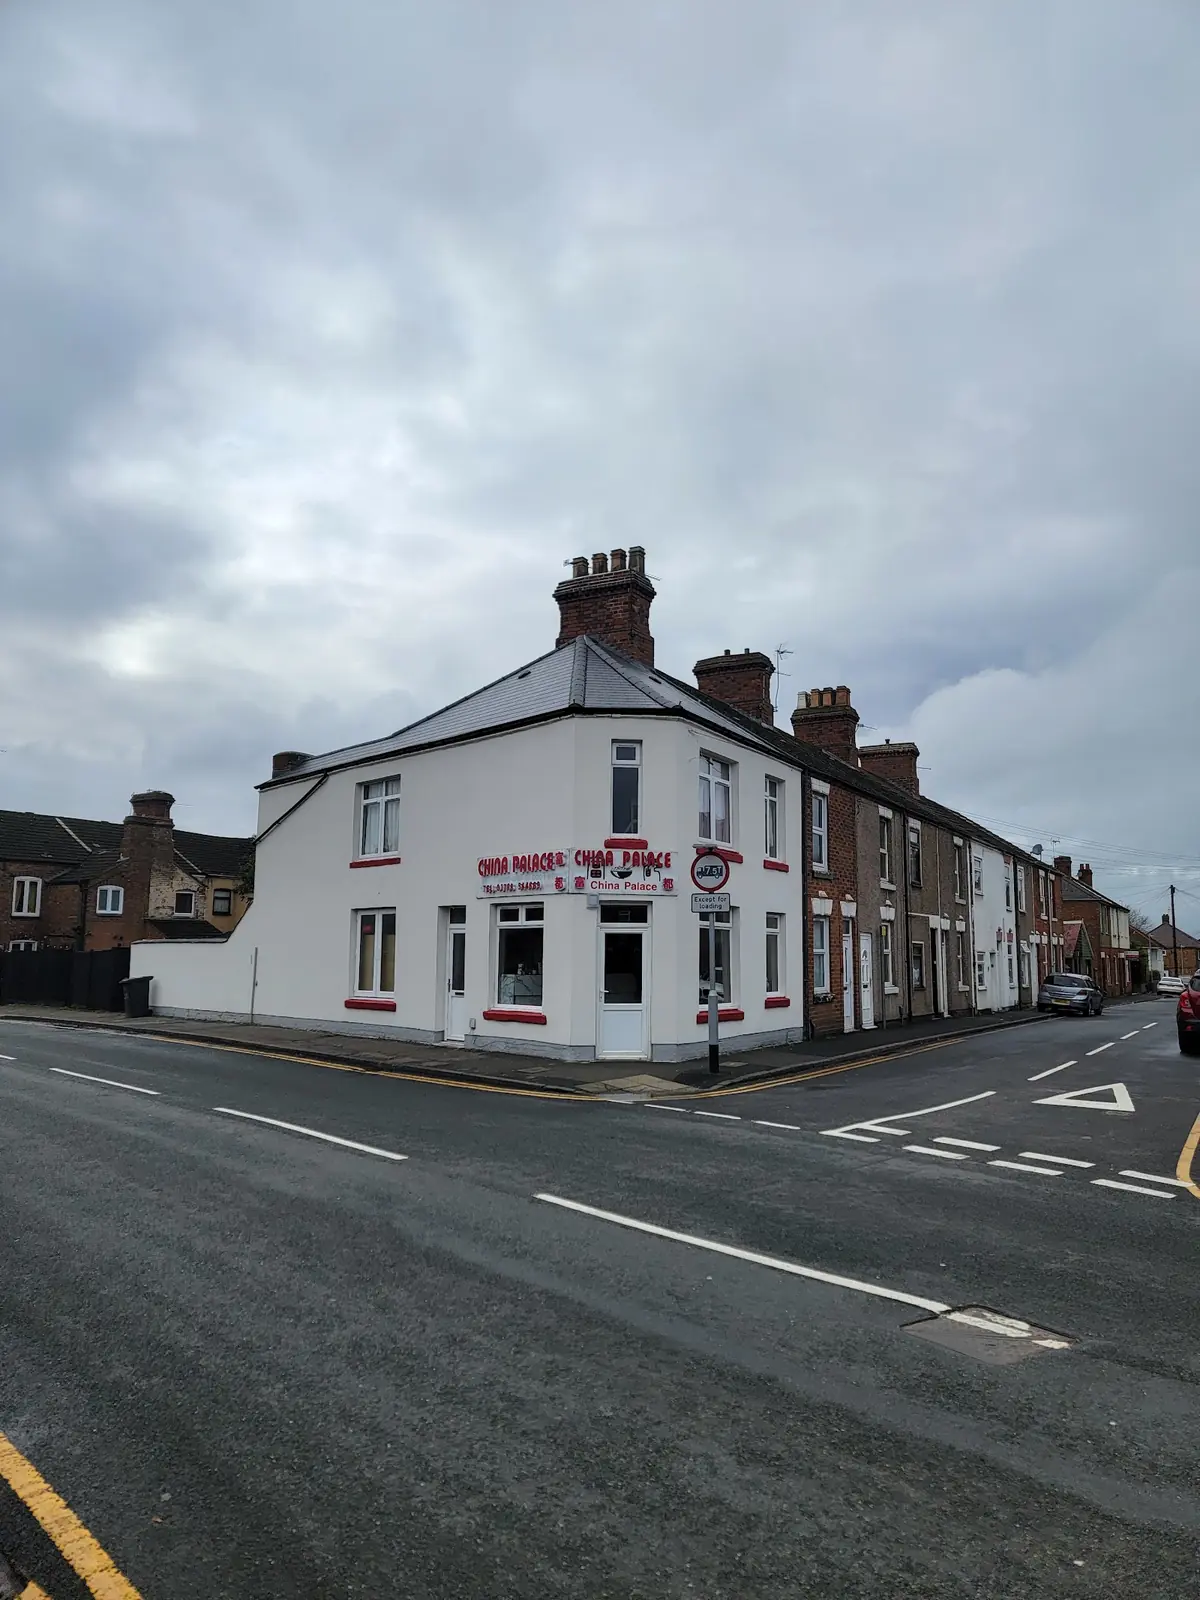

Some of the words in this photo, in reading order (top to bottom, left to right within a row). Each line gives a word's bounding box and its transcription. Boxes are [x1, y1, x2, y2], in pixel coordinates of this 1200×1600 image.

[478, 856, 509, 877] CHINA
[512, 852, 553, 873] PALACE
[574, 849, 614, 867] CHINA
[622, 850, 671, 868] PALACE
[590, 880, 620, 890] China
[624, 881, 657, 891] Palace
